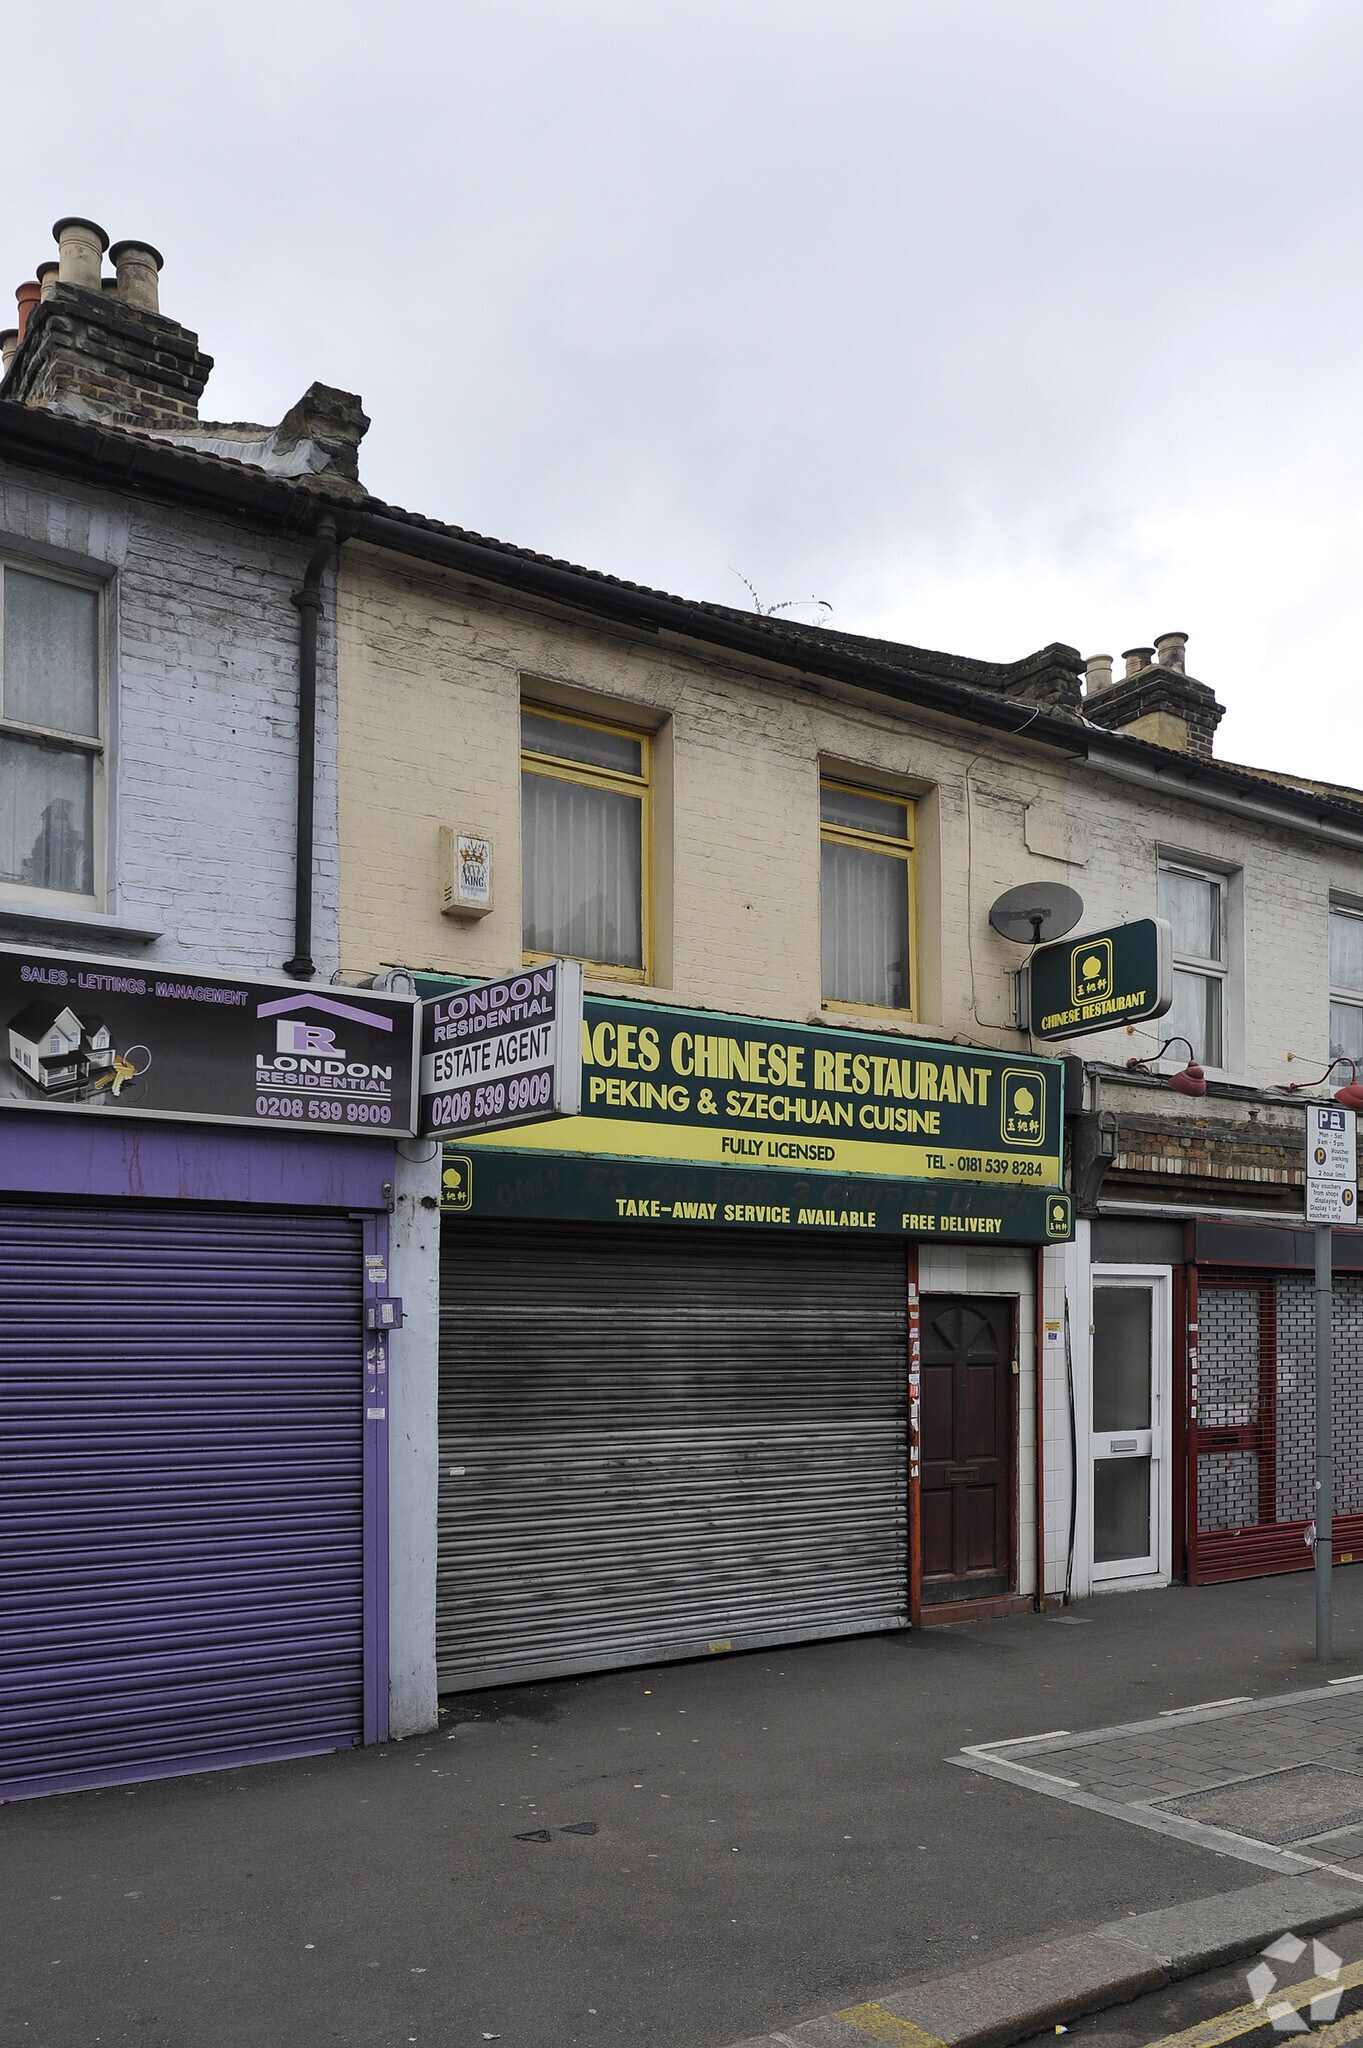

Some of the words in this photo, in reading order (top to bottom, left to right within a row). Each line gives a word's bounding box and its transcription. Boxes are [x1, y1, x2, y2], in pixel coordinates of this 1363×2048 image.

[464, 874, 484, 887] KING
[20, 965, 68, 986] SALES
[78, 972, 146, 995] LETTINGS
[155, 981, 249, 1006] MANAGEMENT
[434, 969, 554, 1025] LONDON
[434, 996, 553, 1043] RESIDENTIAL
[1041, 1007, 1081, 1031] CHINESE
[1082, 990, 1146, 1020] RESTAURANT
[256, 1054, 392, 1080] LONDON
[434, 1042, 491, 1083] ESTATE
[495, 1026, 552, 1069] AGENT
[255, 1070, 392, 1092] RESIDENTIAL
[670, 1031, 806, 1088] CHINESE
[814, 1049, 992, 1107] RESTAURANT
[255, 1096, 303, 1118] 0208
[308, 1100, 342, 1121] 539
[346, 1103, 392, 1124] 9909
[432, 1090, 471, 1127] 0208
[474, 1082, 505, 1118] 539
[508, 1072, 551, 1111] 9909
[589, 1076, 691, 1112] PEKING
[697, 1088, 719, 1116] &
[726, 1090, 853, 1127] SZECHUAN
[859, 1104, 941, 1135] CUISINE
[1319, 1110, 1329, 1128] P
[721, 1136, 764, 1156] FULLY
[767, 1141, 836, 1162] LICENSED
[925, 1153, 946, 1170] TEL
[957, 1155, 983, 1173] 0181
[984, 1157, 1008, 1175] 539
[1011, 1159, 1043, 1177] 8284
[1311, 1181, 1320, 1189] Buy
[1325, 1190, 1339, 1198] shops
[1310, 1204, 1327, 1213] Display
[1314, 1197, 1338, 1206] displaying
[616, 1198, 718, 1220] TAKE-AWAY
[724, 1204, 791, 1224] SERVICE
[797, 1208, 877, 1228] AVAILABLE
[902, 1213, 936, 1231] FREE
[940, 1215, 1002, 1234] DELIVERY
[1331, 1213, 1341, 1221] only
